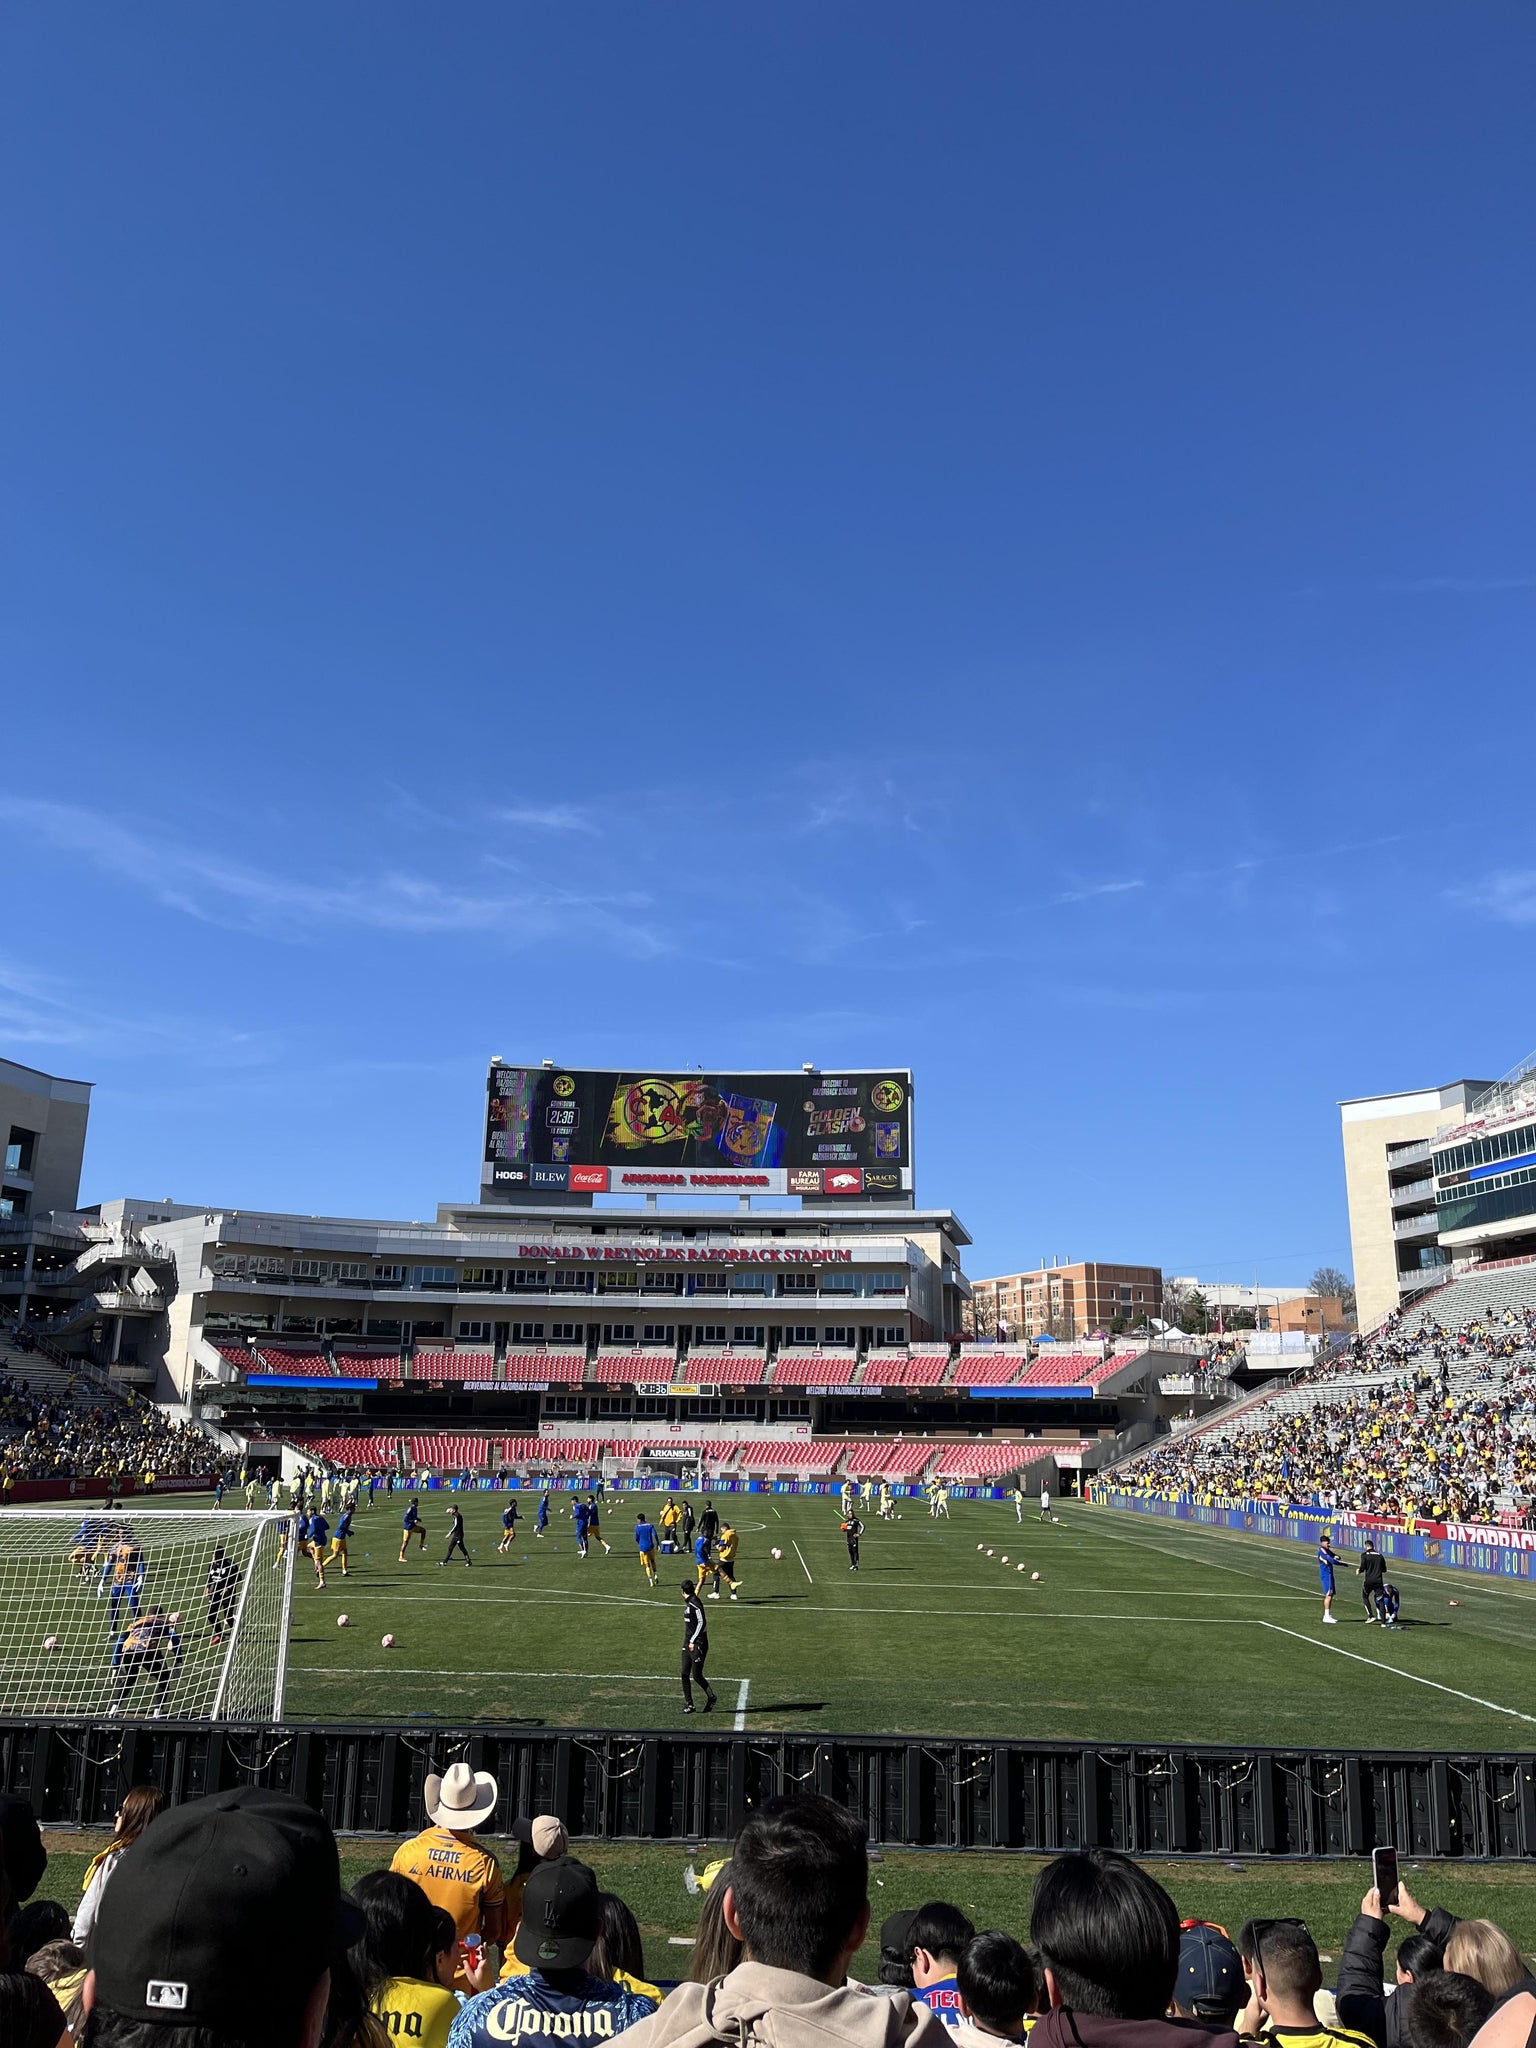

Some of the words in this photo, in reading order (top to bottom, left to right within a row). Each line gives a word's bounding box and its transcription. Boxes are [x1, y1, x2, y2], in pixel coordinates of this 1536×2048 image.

[550, 1110, 575, 1124] 21:36
[809, 1107, 861, 1124] GOLDEN
[806, 1120, 849, 1137] CLASH
[535, 1172, 566, 1182] BLEW
[621, 1173, 686, 1186] ARKANSAS
[689, 1174, 769, 1187] RAZORBACKS
[790, 1177, 820, 1185] BUREAU
[798, 1170, 820, 1178] FARM
[518, 1245, 583, 1259] DONALD
[585, 1247, 602, 1259] W
[603, 1248, 685, 1261] REYNOLDS
[687, 1249, 782, 1262] RAZORBACK
[784, 1249, 852, 1263] STADIUM
[463, 1381, 494, 1390] BIENVENIDOS
[494, 1381, 500, 1390] AL
[500, 1382, 529, 1391] RAZORBACK
[528, 1382, 550, 1391] STADIUM
[805, 1386, 828, 1395] WELCOME
[834, 1386, 861, 1395] RAZORBACK
[861, 1386, 882, 1395] STADIUM
[649, 1449, 696, 1458] ARKANSAS
[1450, 1543, 1529, 1576] AMESHOP.COM
[428, 1848, 462, 1864] TECATE
[425, 1864, 475, 1883] AFIRME
[543, 1900, 561, 1929] LA
[486, 1997, 615, 2046] Corona
